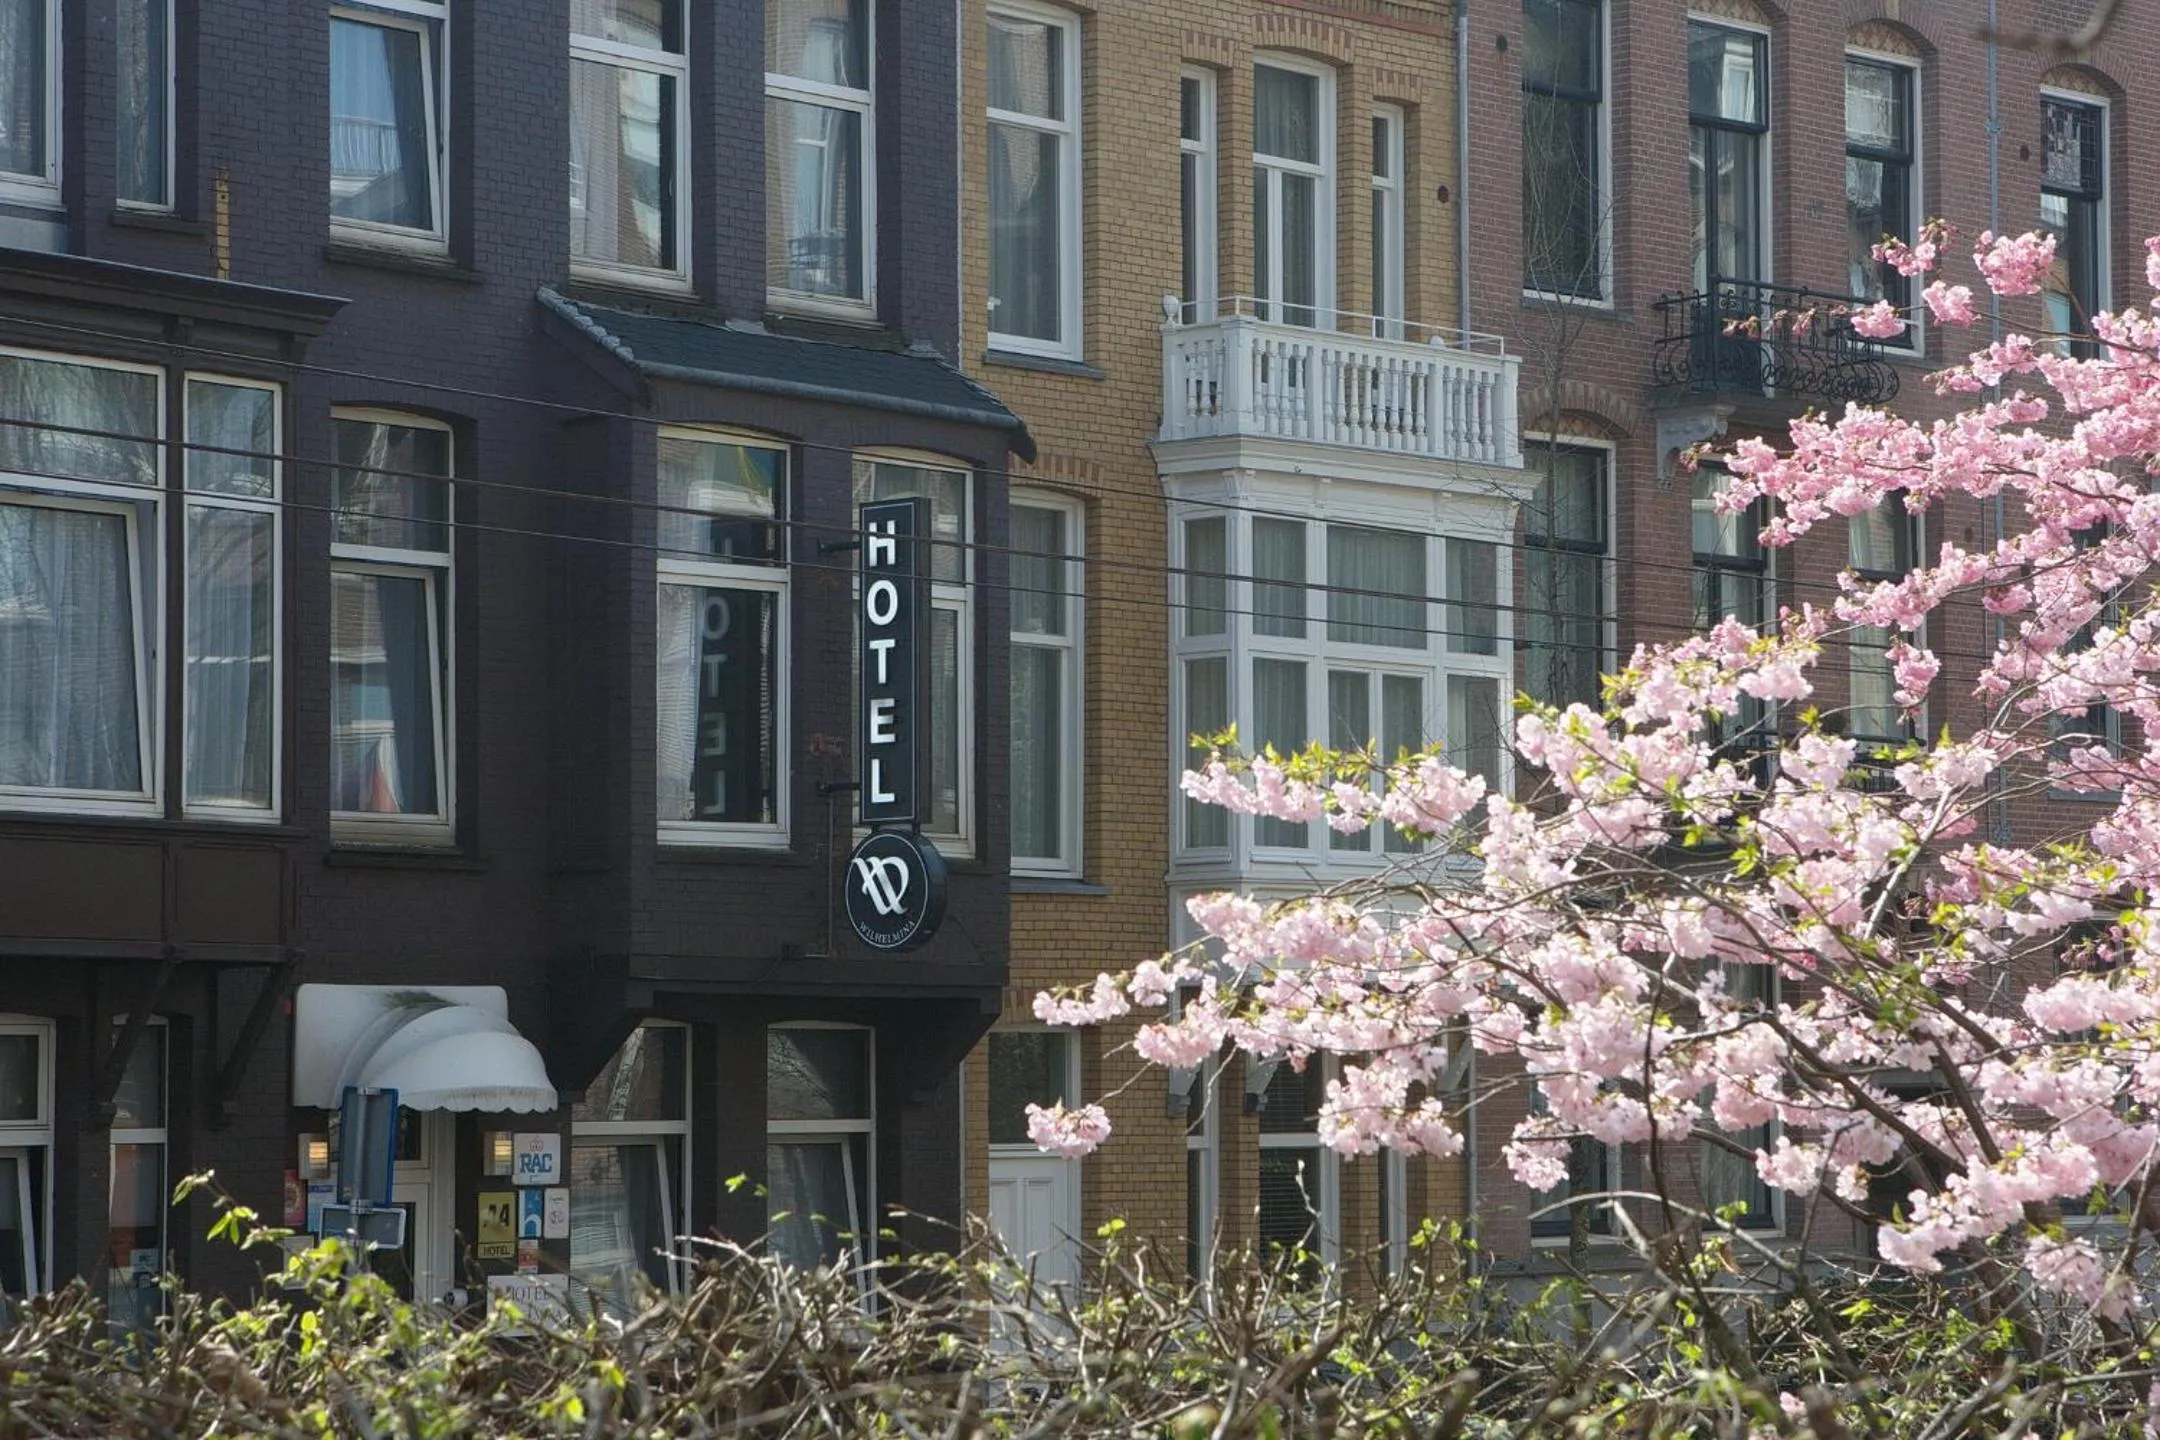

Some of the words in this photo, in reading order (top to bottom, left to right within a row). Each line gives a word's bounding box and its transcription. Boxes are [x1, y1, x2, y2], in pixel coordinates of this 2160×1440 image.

[866, 520, 898, 804] HOTEL
[860, 921, 915, 943] WILHELMINA
[519, 1153, 552, 1173] RAC
[483, 1245, 510, 1257] HOTEL
